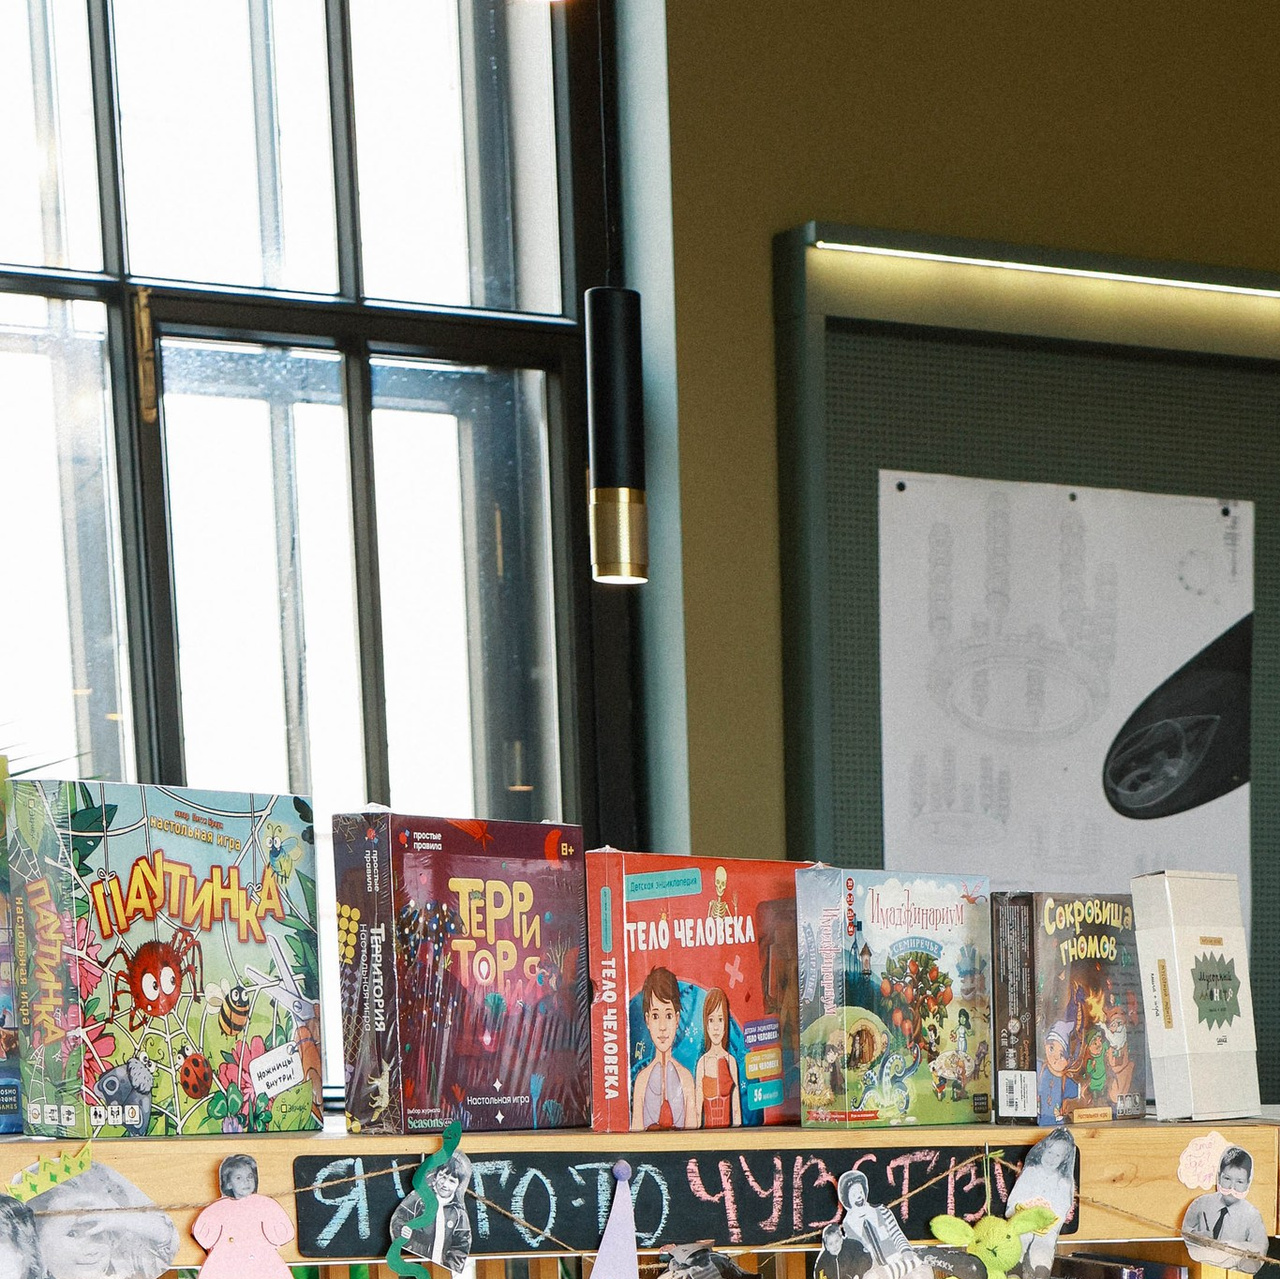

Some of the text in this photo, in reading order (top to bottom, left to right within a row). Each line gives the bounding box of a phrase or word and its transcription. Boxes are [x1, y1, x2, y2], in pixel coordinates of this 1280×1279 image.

[150, 816, 214, 843] настольная
[217, 831, 242, 851] игра
[413, 831, 442, 841] простые
[413, 840, 442, 851] правила
[560, 842, 574, 856] 8+
[365, 849, 373, 893] правила
[372, 849, 380, 893] простые
[91, 849, 286, 944] ПАУТИНКА
[869, 888, 965, 934] Имаджинариум
[626, 915, 755, 952] ТЕЛО ЧЕЛОВЕКА
[14, 896, 30, 1026] настольная игра
[25, 876, 65, 1046] ПАУТИНКА
[369, 922, 386, 1033] ТЕРРИТОРИЯ
[601, 957, 620, 1100] ТЕЛО ЧЕЛОВЕКА
[407, 1113, 443, 1129] Seasons
[467, 1093, 529, 1105] Настольная игра
[315, 1156, 365, 1247] Я
[391, 1158, 669, 1250] ТО-ТО
